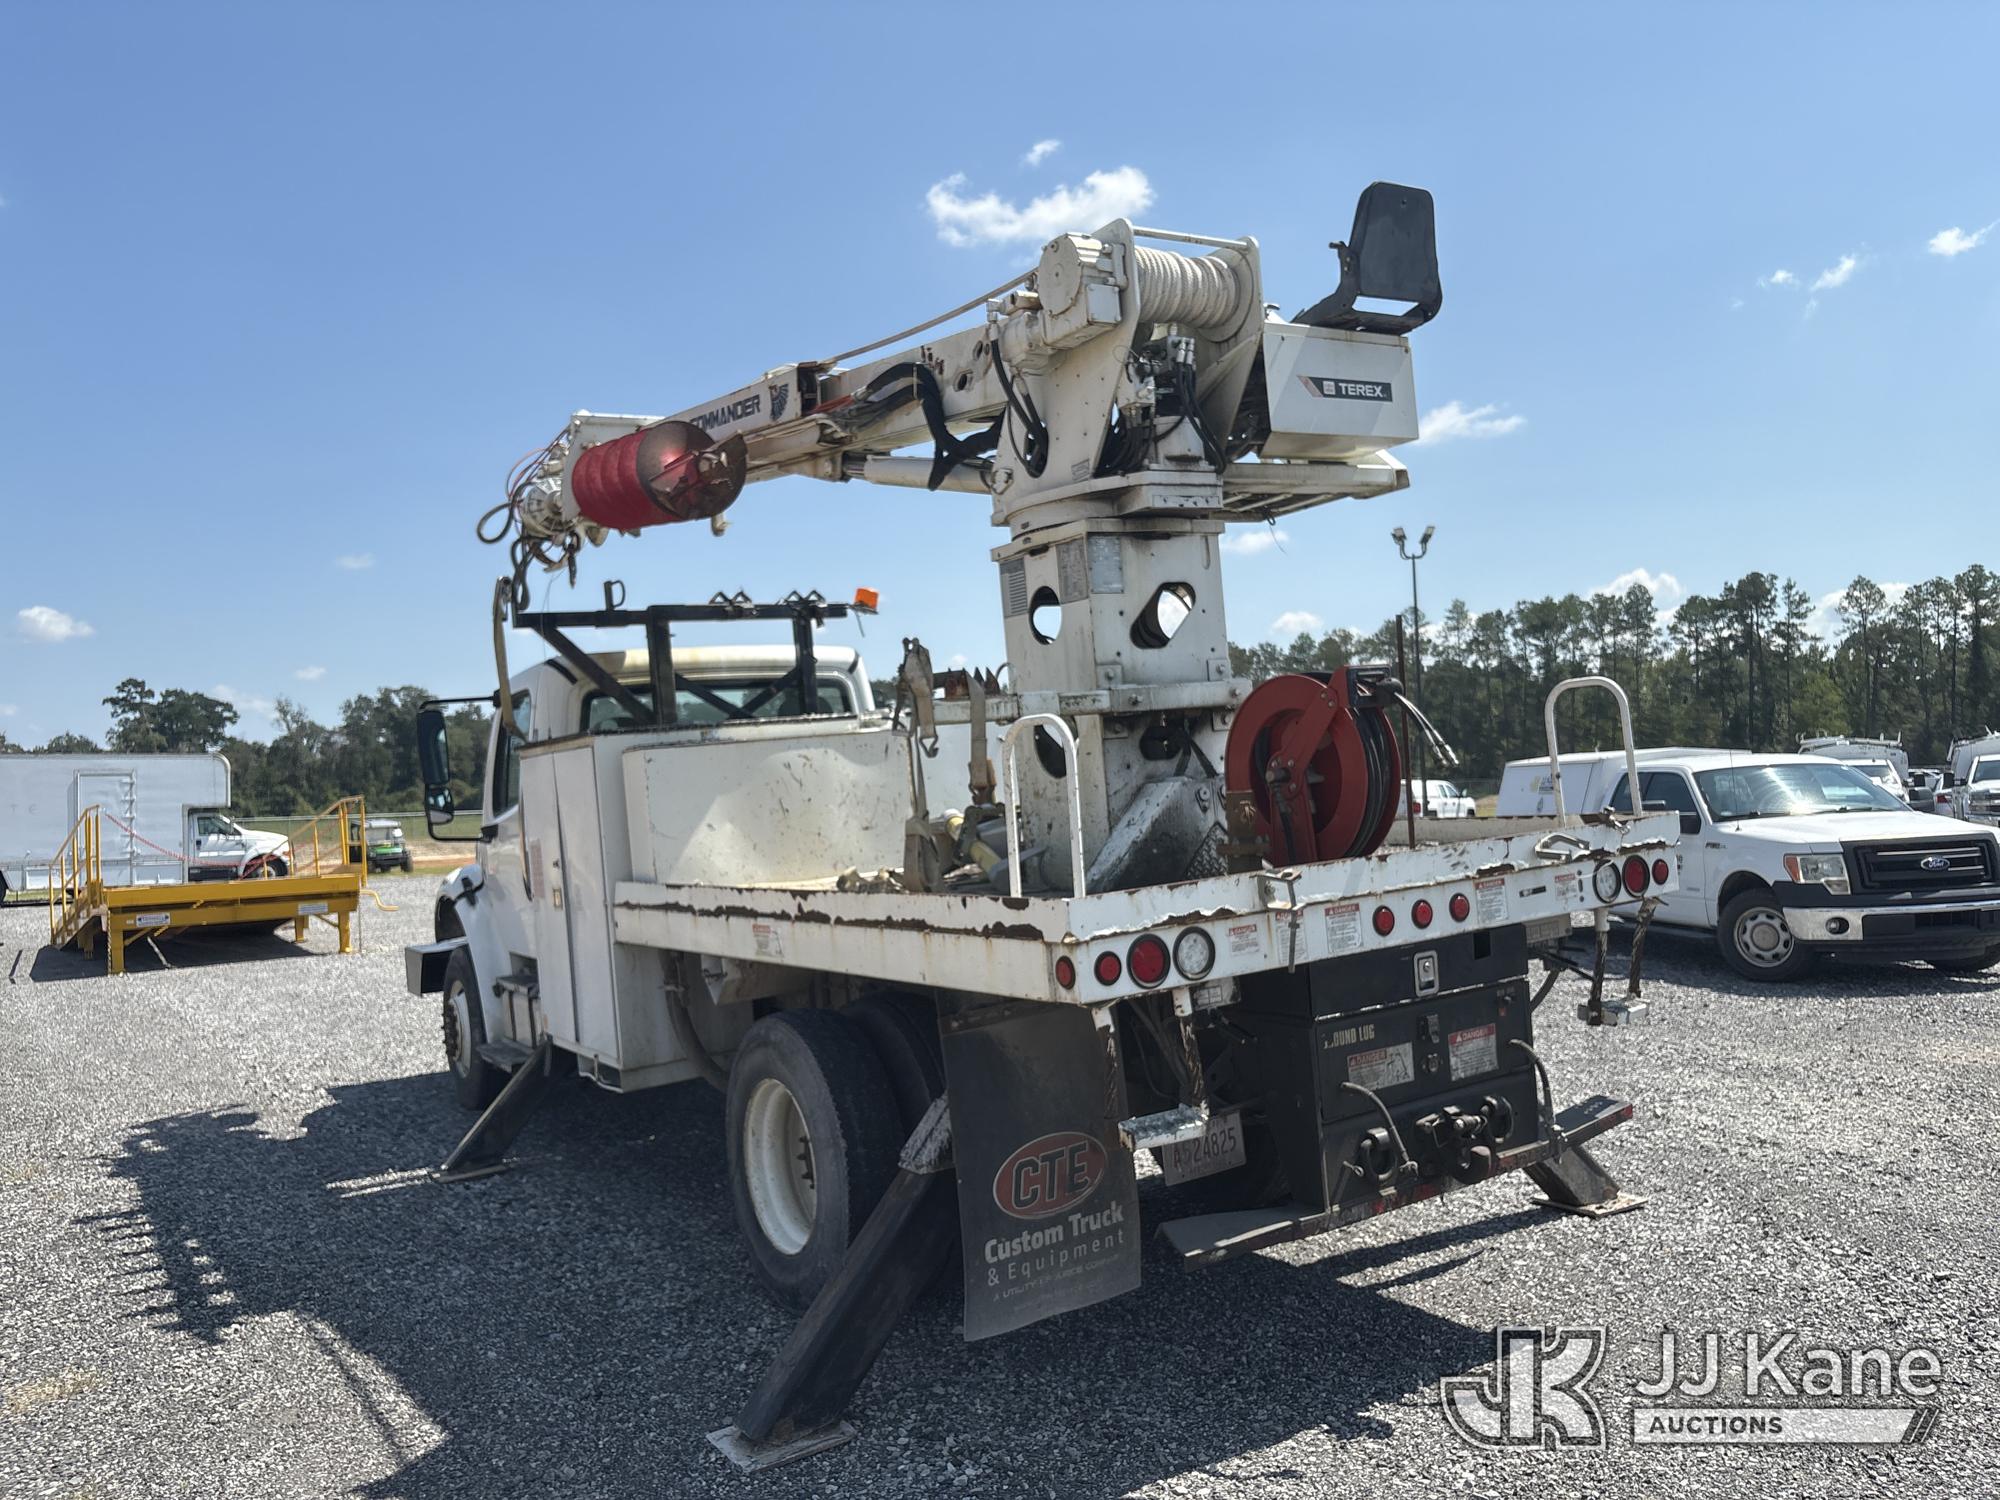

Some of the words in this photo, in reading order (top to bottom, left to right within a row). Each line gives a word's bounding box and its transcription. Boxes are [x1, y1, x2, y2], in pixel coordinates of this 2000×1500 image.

[1338, 382, 1384, 398] TEREX
[1334, 904, 1356, 913] DANGER
[1358, 1023, 1376, 1041] LUG
[1461, 1028, 1489, 1041] DANGER
[1356, 1051, 1386, 1066] DANGER
[1011, 1139, 1091, 1210] CTE
[984, 1223, 1065, 1265] Custom
[1067, 1200, 1125, 1237] Truck
[987, 1267, 1000, 1287] &
[1007, 1228, 1124, 1281] Equipment
